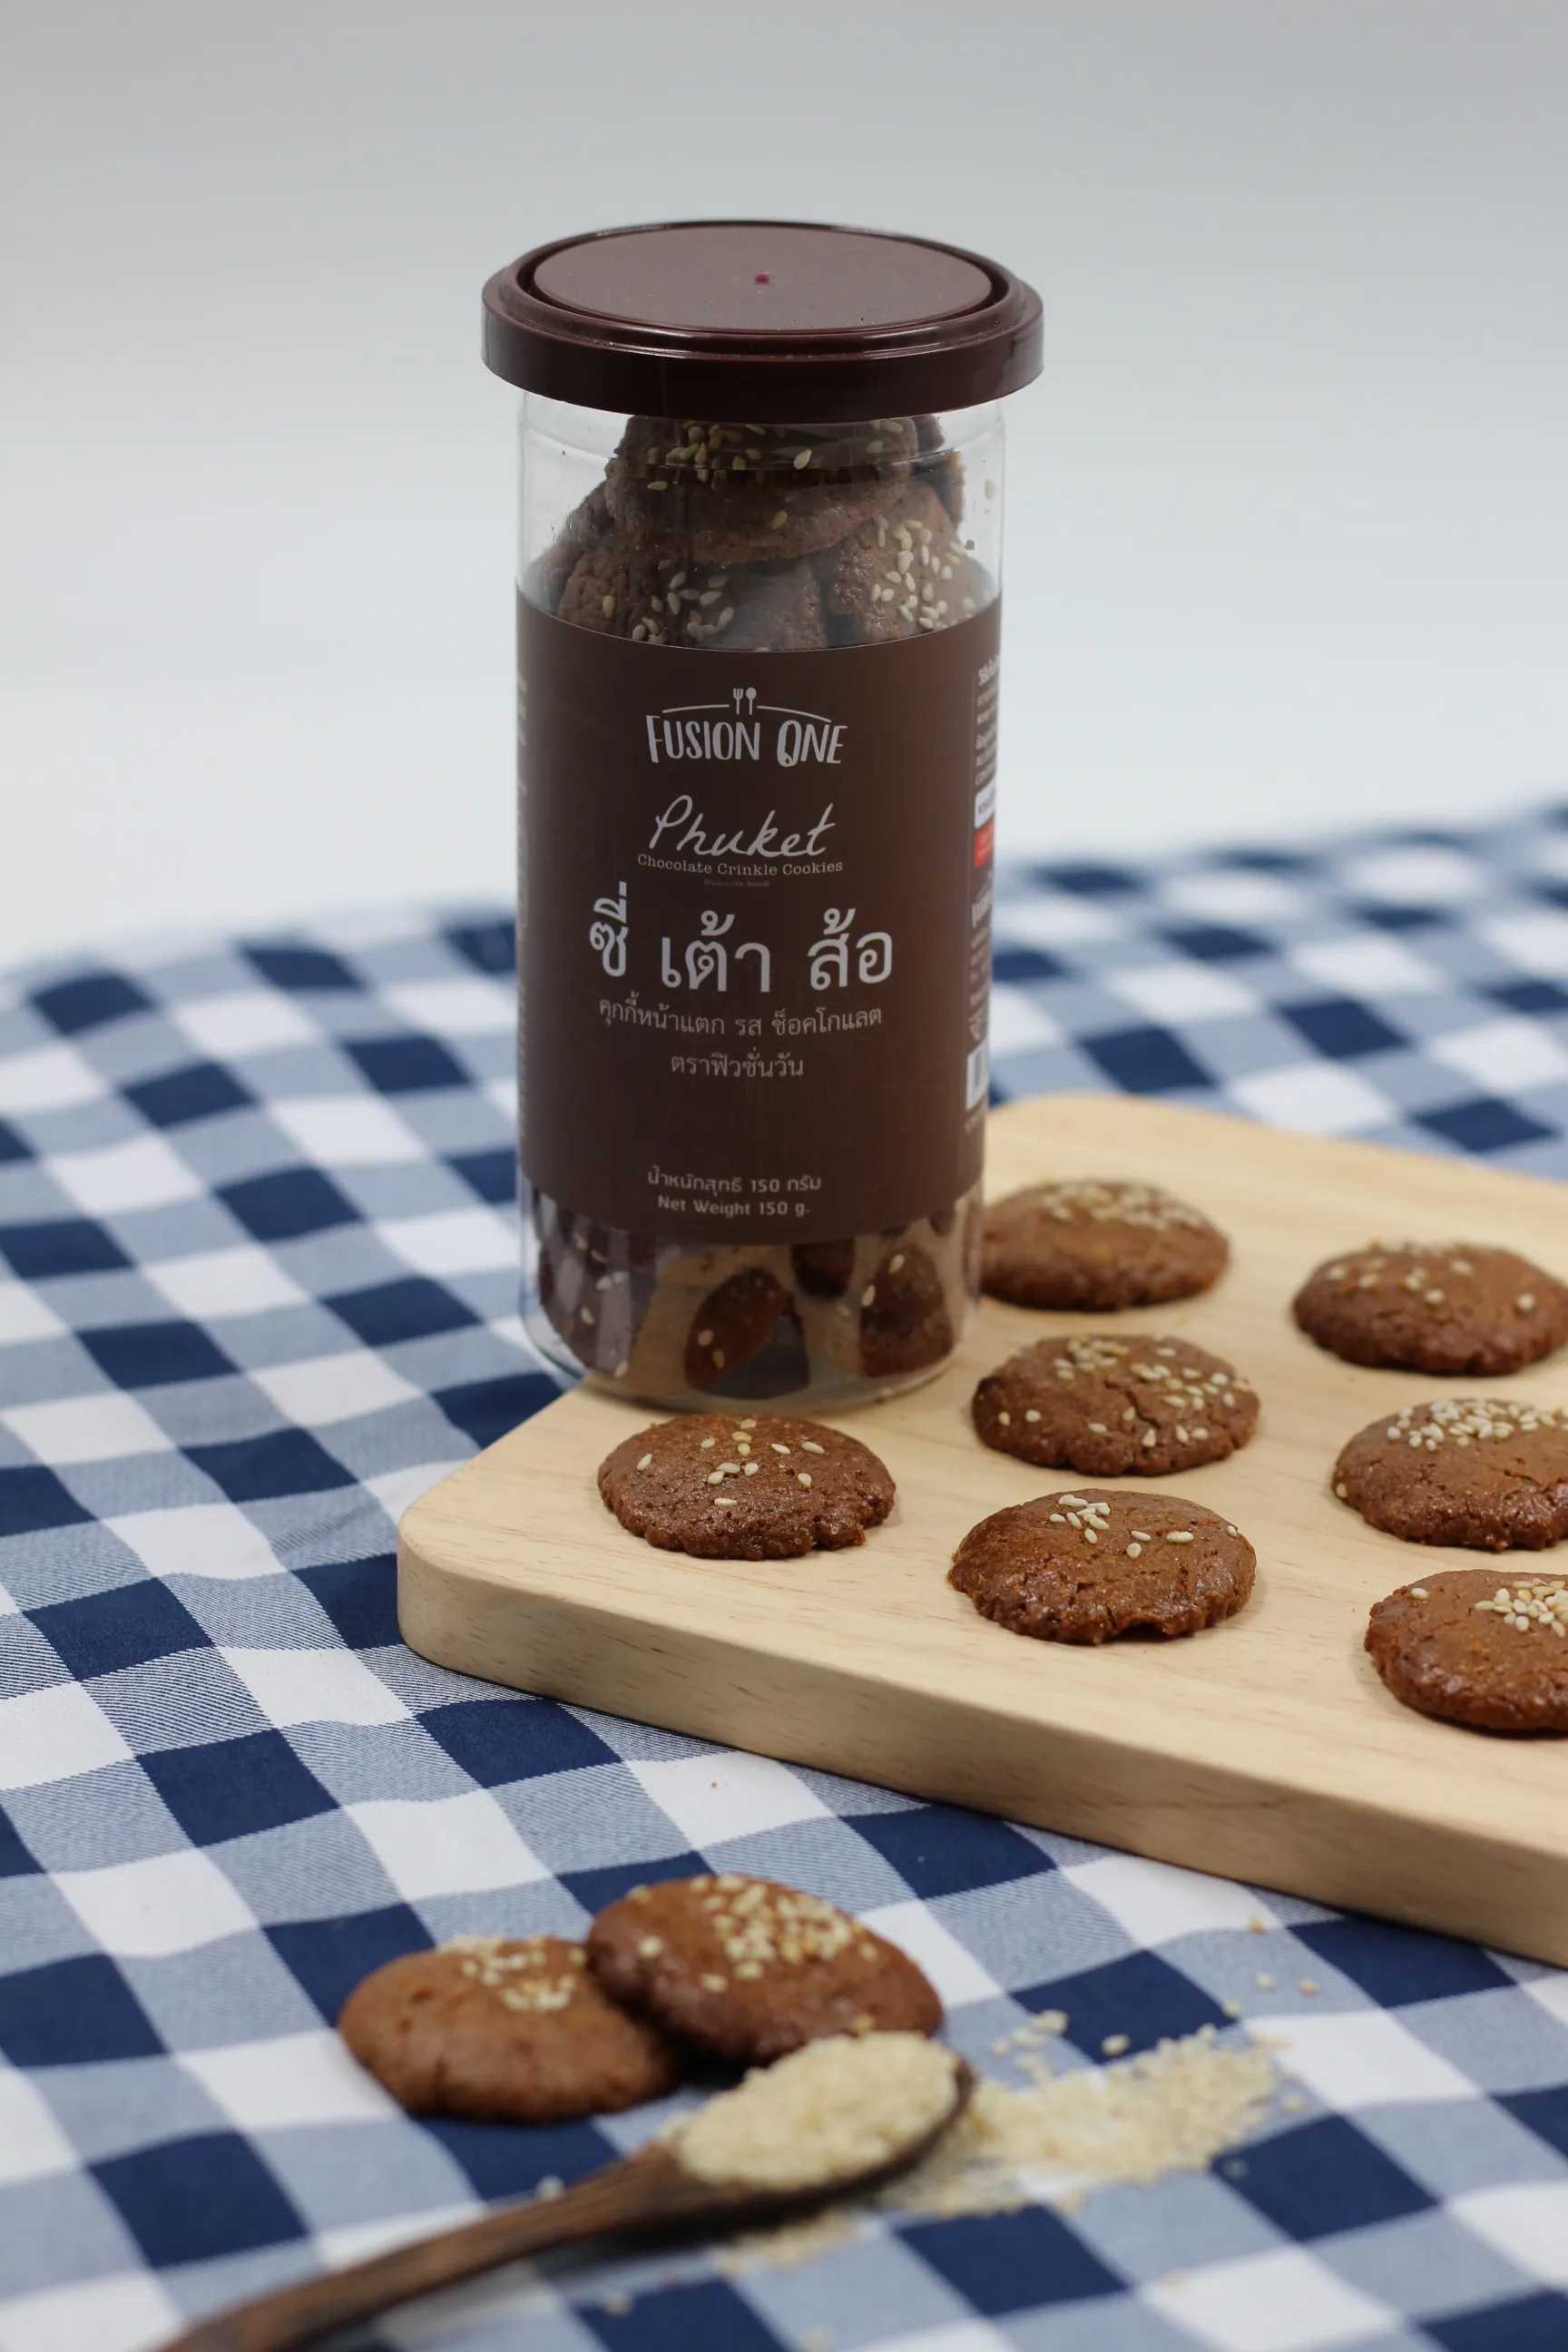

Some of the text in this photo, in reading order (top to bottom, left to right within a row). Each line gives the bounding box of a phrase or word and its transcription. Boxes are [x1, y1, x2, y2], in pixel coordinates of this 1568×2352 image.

[645, 715, 848, 768] FUSION ONE
[649, 794, 836, 858] Phuket
[637, 854, 843, 876] Chocolate Crinkle Cookies
[589, 880, 630, 977] ซี่
[661, 909, 771, 993] เต้า
[807, 907, 893, 991] ส้อ
[599, 990, 725, 1035] คุกกี้หน้าแตก
[735, 1018, 762, 1036] รส
[671, 1046, 804, 1077] ตราฟิวชั่นวัน
[750, 1179, 780, 1193] 150
[787, 1174, 822, 1191] กรัม
[658, 1194, 810, 1219] Net Weight 150 g.
